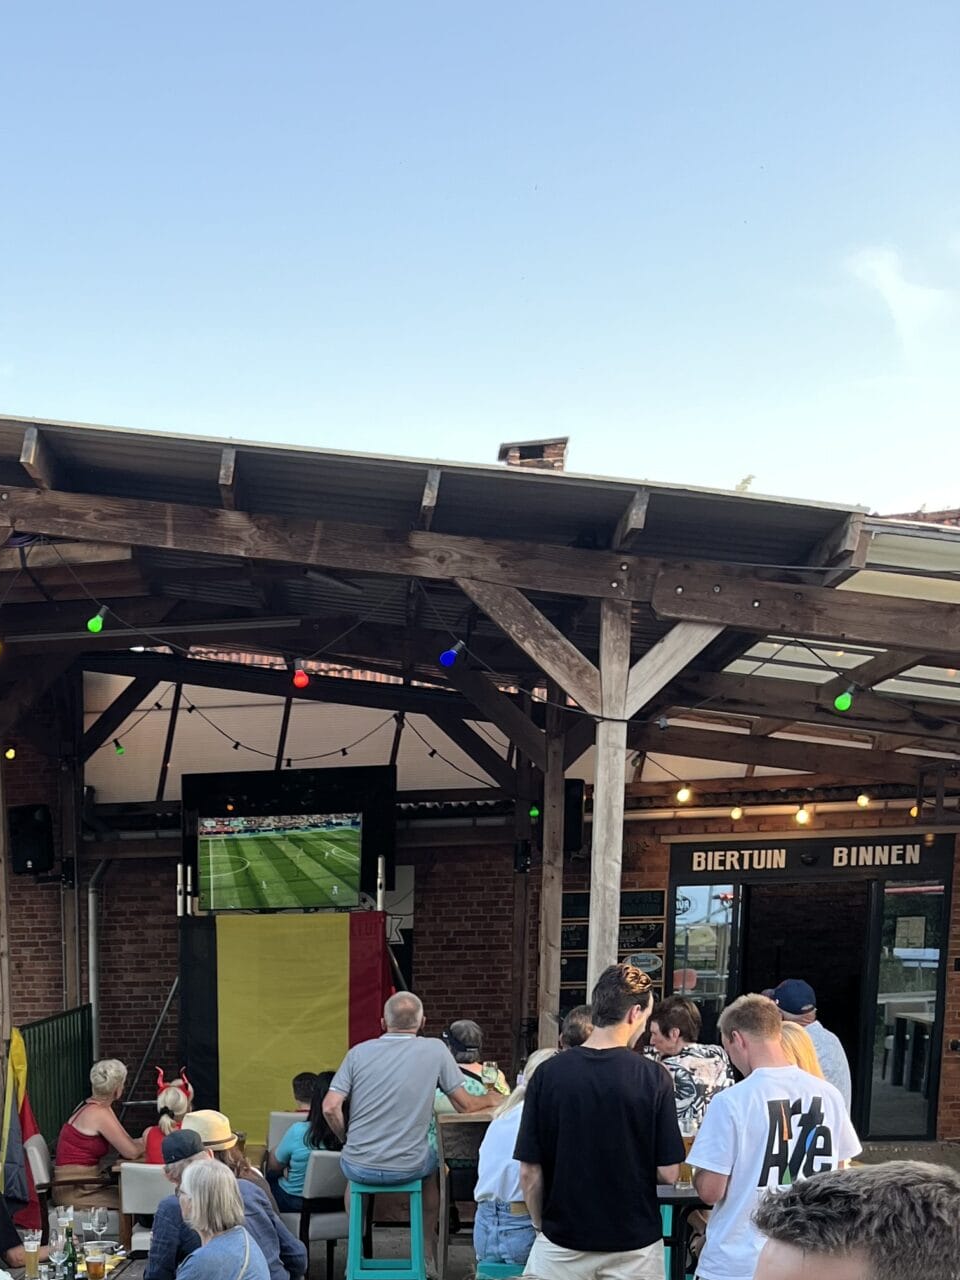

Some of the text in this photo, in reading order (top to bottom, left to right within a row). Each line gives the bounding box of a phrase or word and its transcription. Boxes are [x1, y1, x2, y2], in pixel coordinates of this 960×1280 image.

[692, 844, 921, 872] BIERTUIN BINNEN
[757, 1096, 834, 1188] Arte
